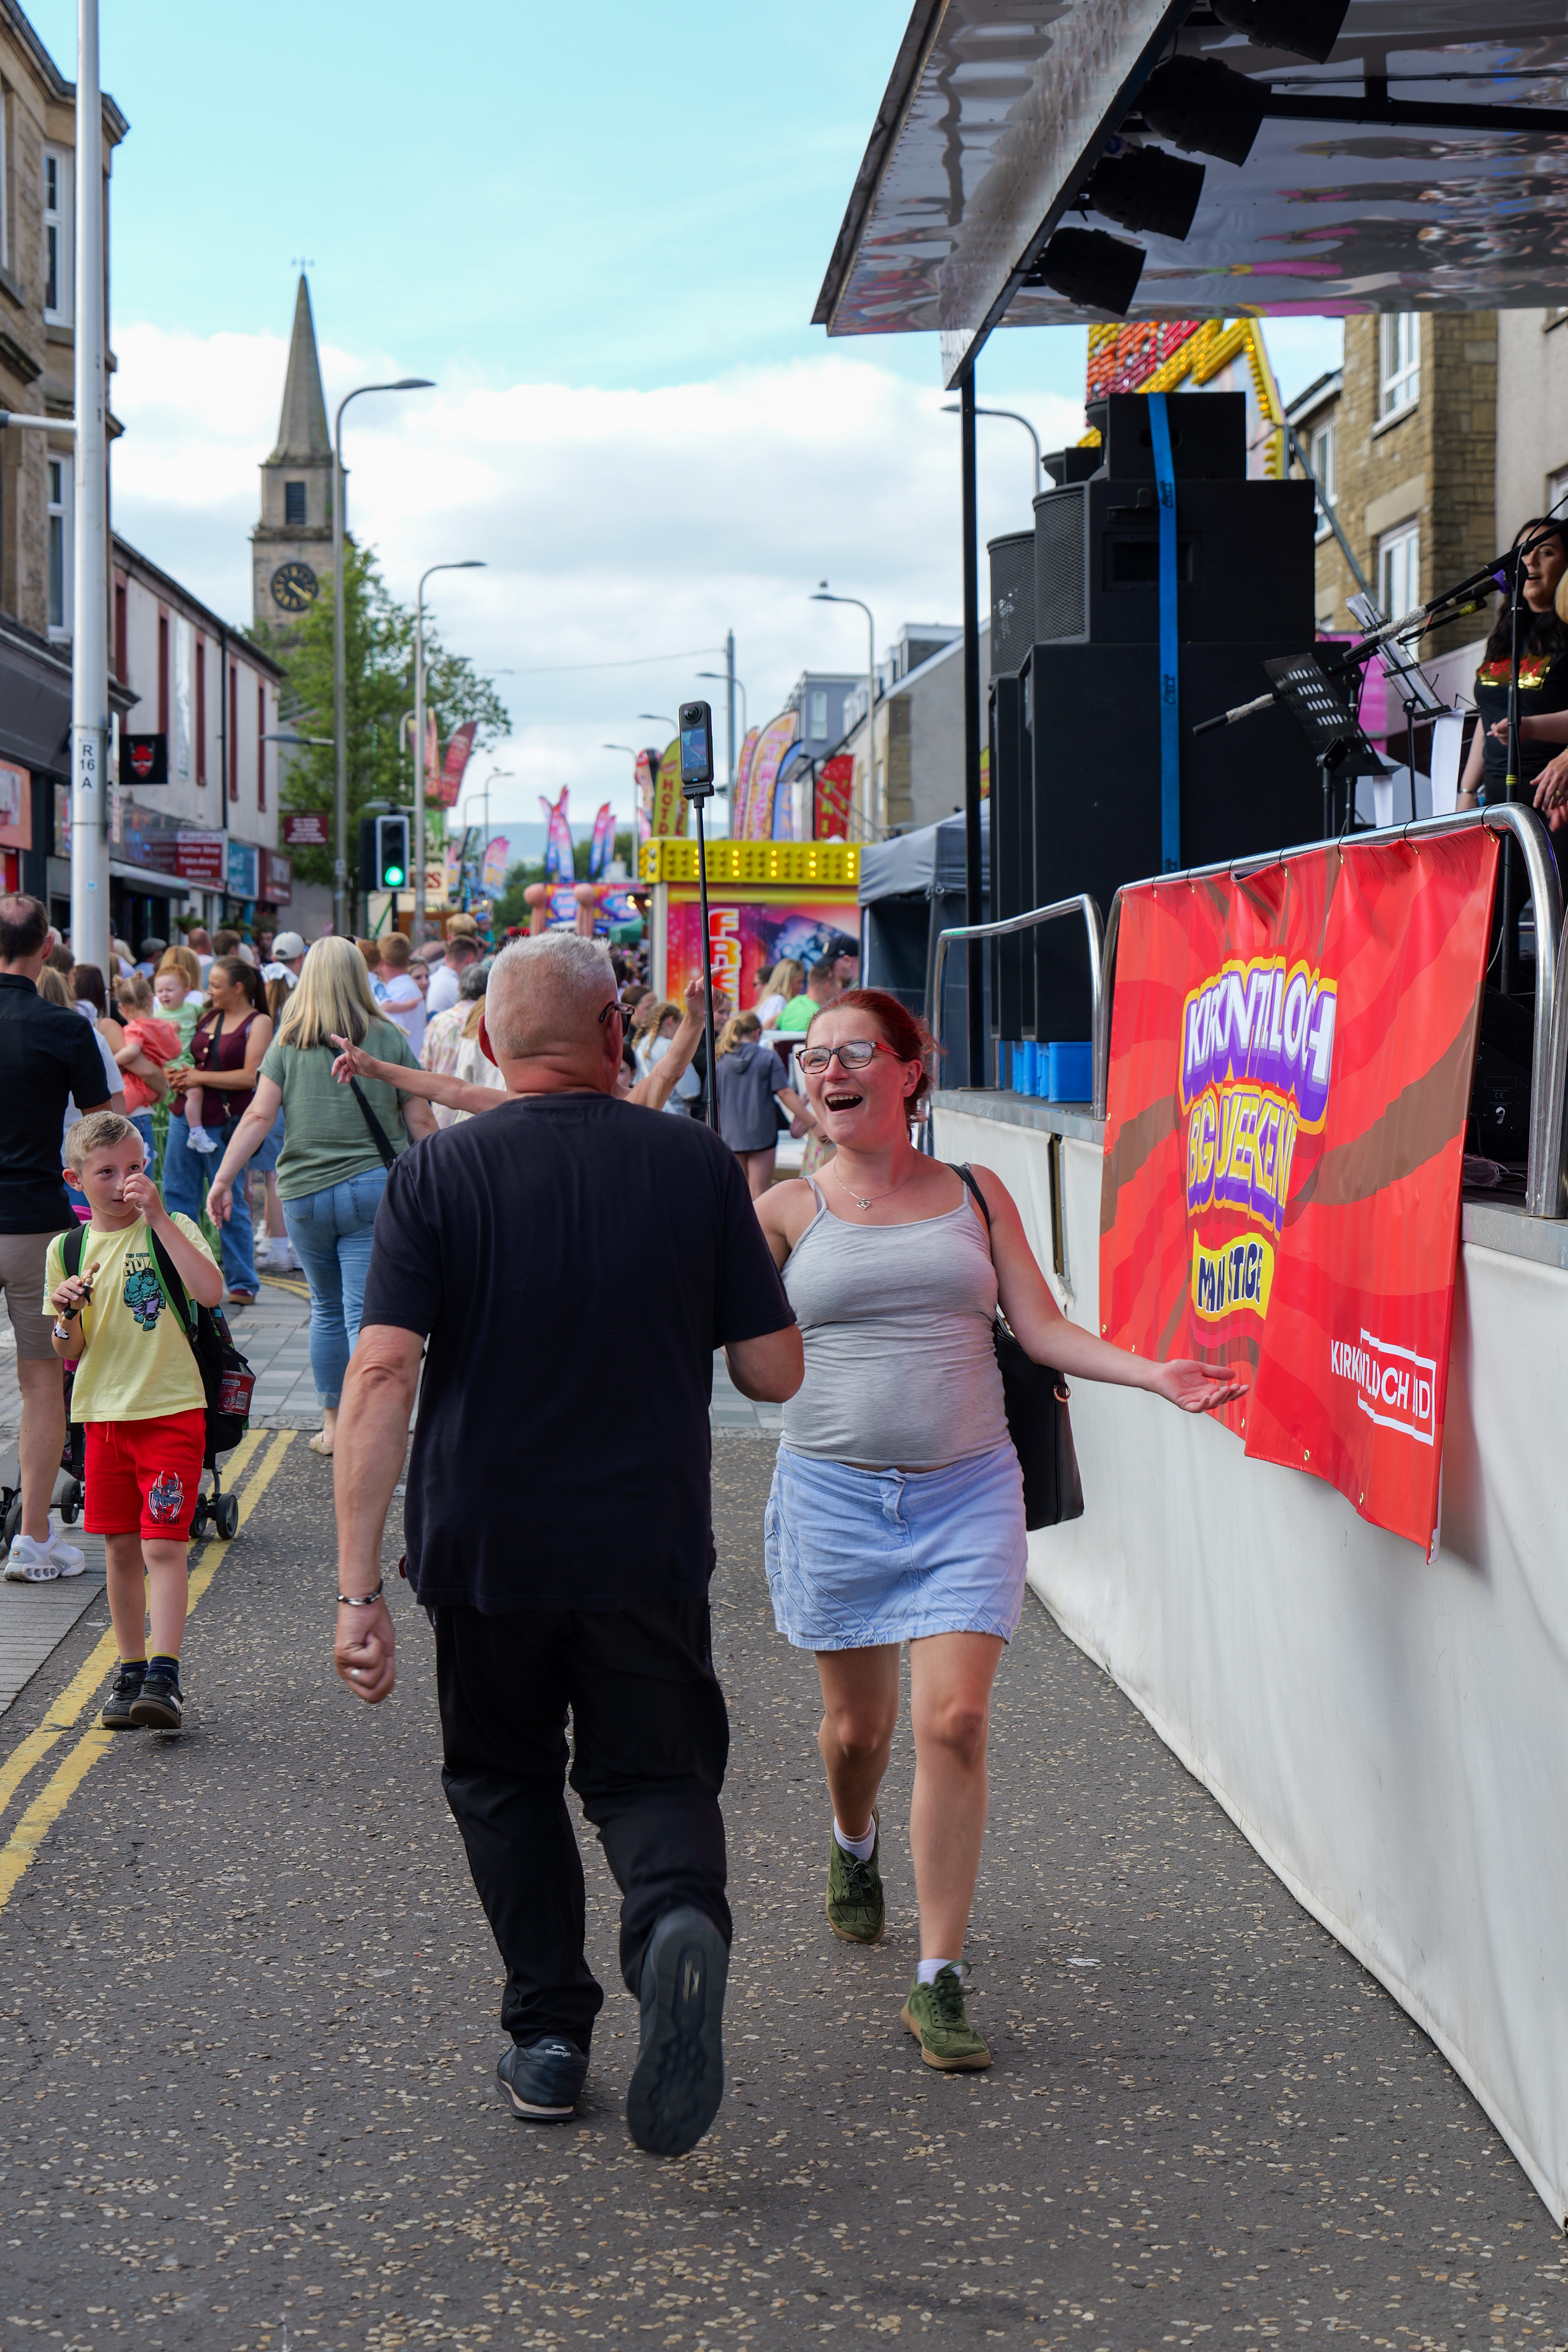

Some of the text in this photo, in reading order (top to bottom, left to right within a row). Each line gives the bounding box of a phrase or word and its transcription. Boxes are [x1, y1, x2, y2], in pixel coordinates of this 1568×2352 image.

[83, 745, 93, 756] R
[80, 758, 95, 771] 16
[82, 777, 92, 788] A
[545, 2048, 571, 2057] Slazenger
